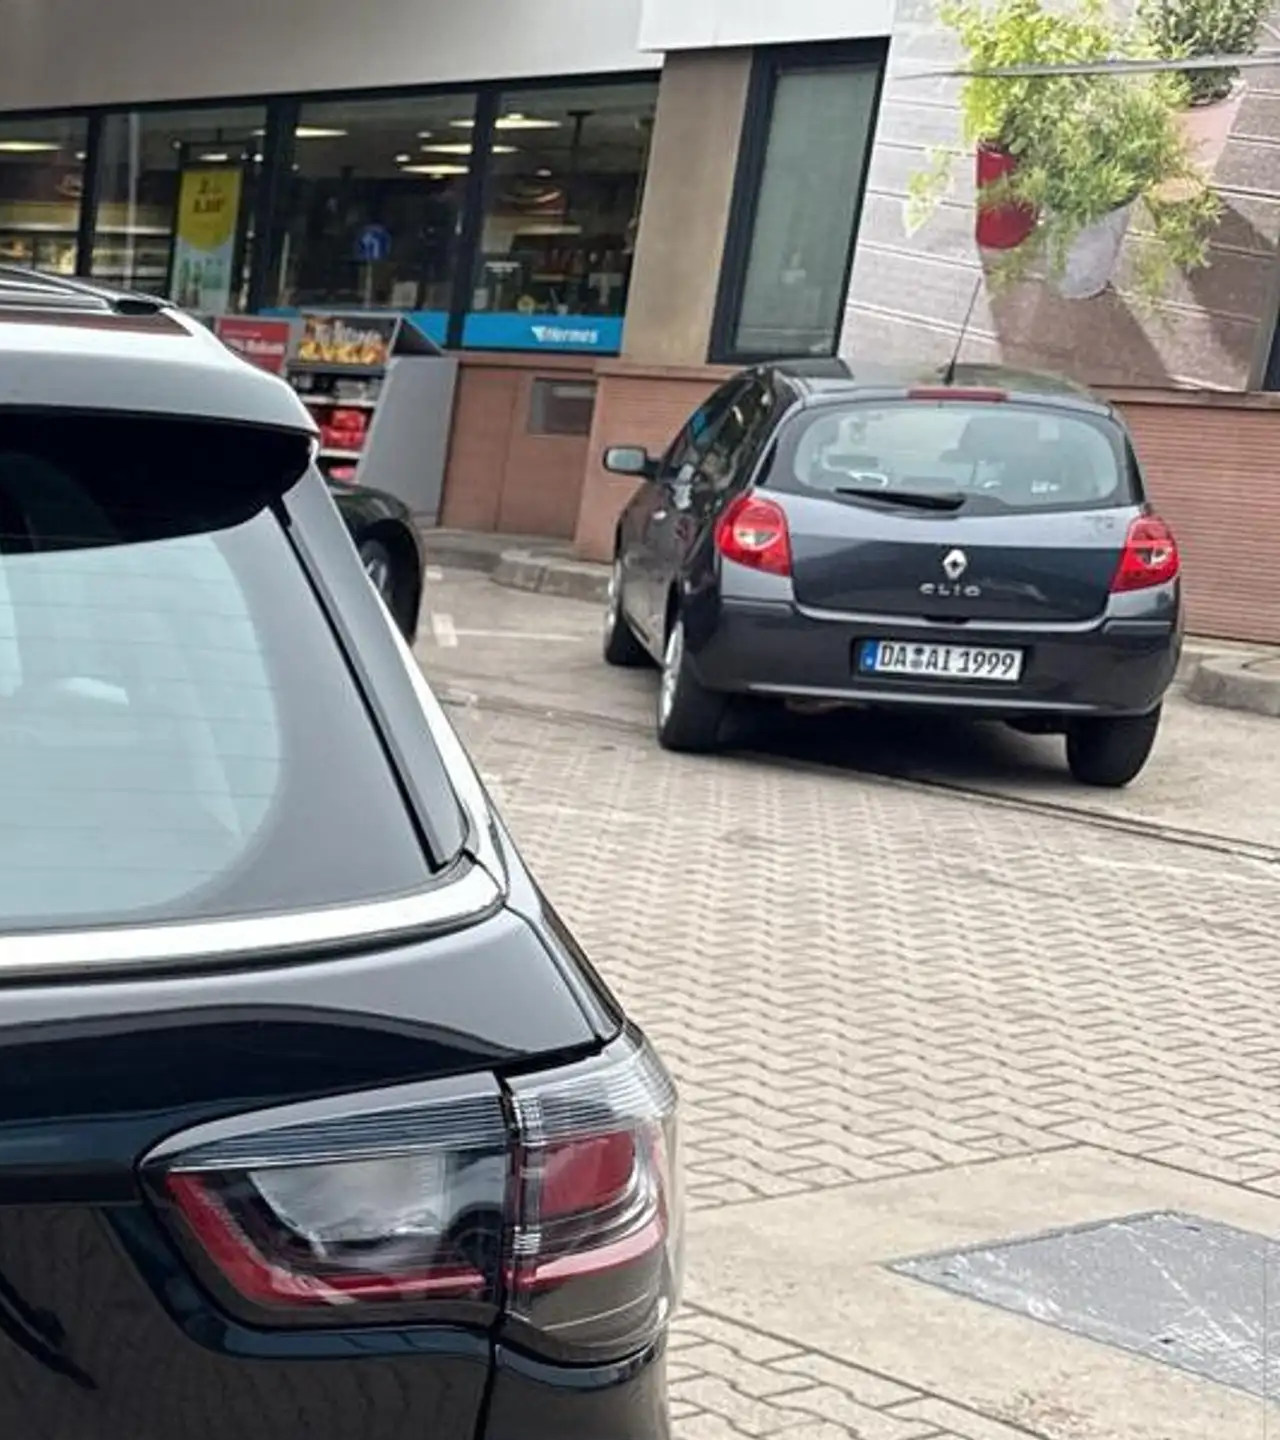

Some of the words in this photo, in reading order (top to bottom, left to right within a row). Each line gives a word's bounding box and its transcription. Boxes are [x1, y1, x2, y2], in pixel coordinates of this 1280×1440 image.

[919, 582, 982, 597] CLIO
[879, 643, 907, 669] DA
[925, 646, 951, 672] AI
[957, 650, 1015, 676] 1999
